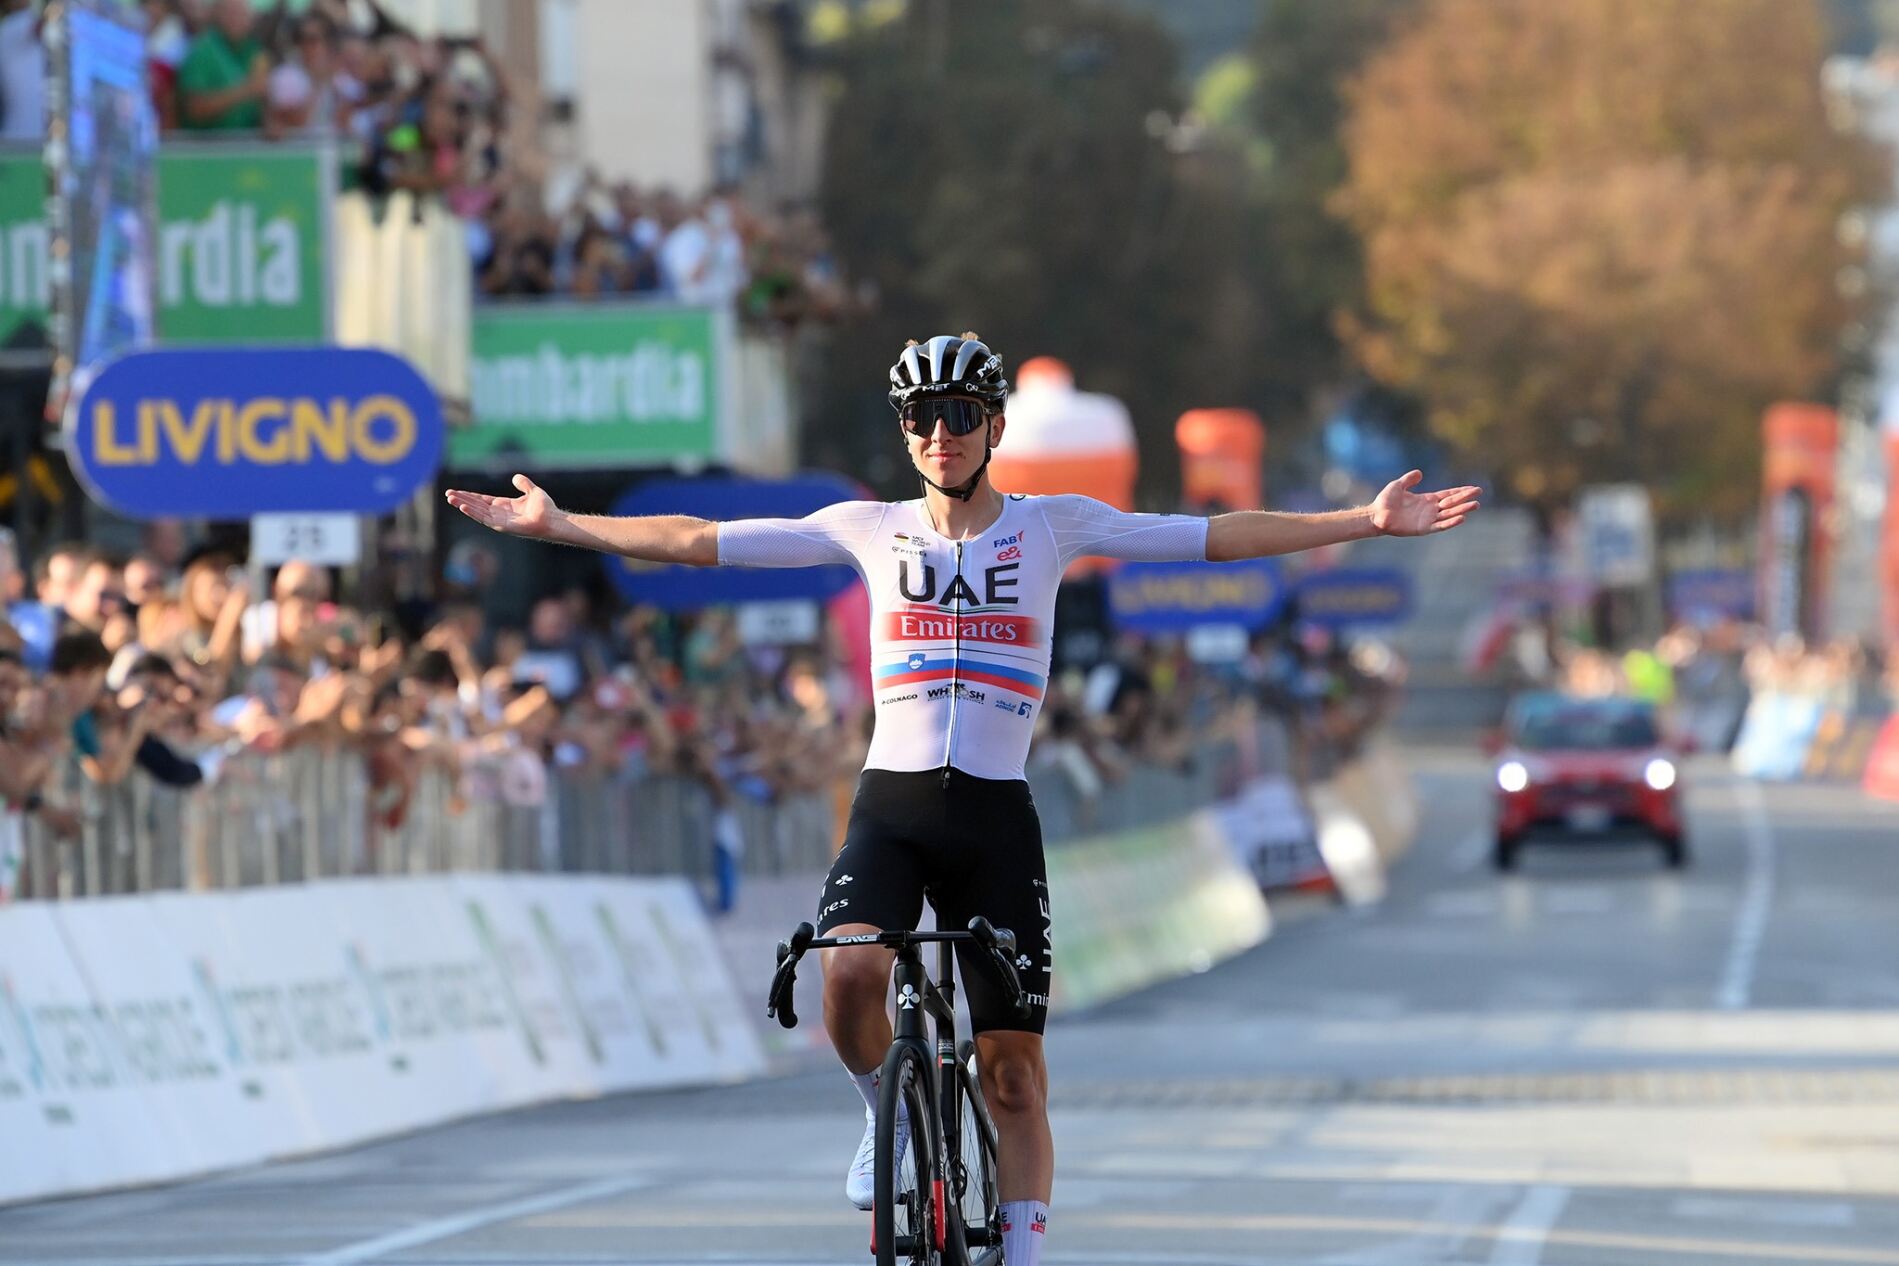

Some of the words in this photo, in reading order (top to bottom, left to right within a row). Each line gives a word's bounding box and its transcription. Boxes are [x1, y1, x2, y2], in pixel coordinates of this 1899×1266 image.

[93, 394, 418, 464] LIVIGNO
[899, 560, 1020, 606] UAE
[901, 616, 1016, 640] Emirates
